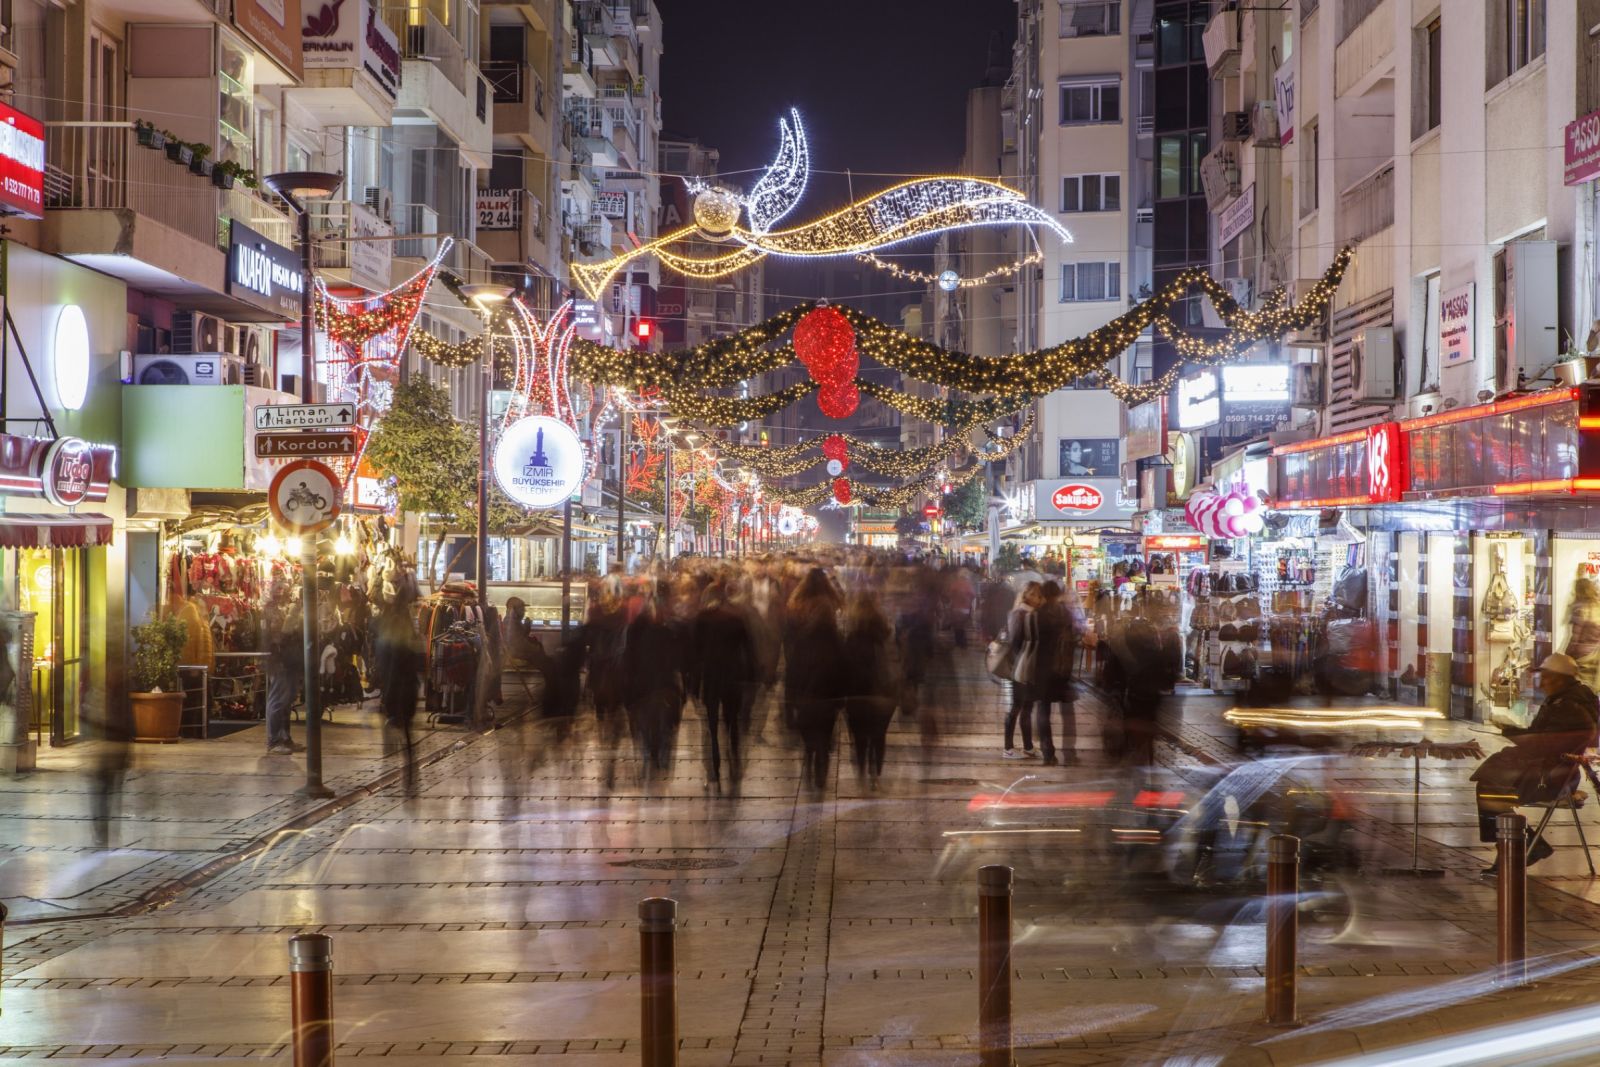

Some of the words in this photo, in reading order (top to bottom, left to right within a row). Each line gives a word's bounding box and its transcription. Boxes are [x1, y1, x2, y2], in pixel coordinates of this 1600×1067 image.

[497, 212, 510, 225] 44
[238, 243, 271, 297] KUAFÖR
[277, 408, 327, 417] Liman
[271, 415, 334, 425] (Harbour)
[277, 440, 339, 451] Kordon
[512, 477, 566, 487] BÜYÜKŞEHİR
